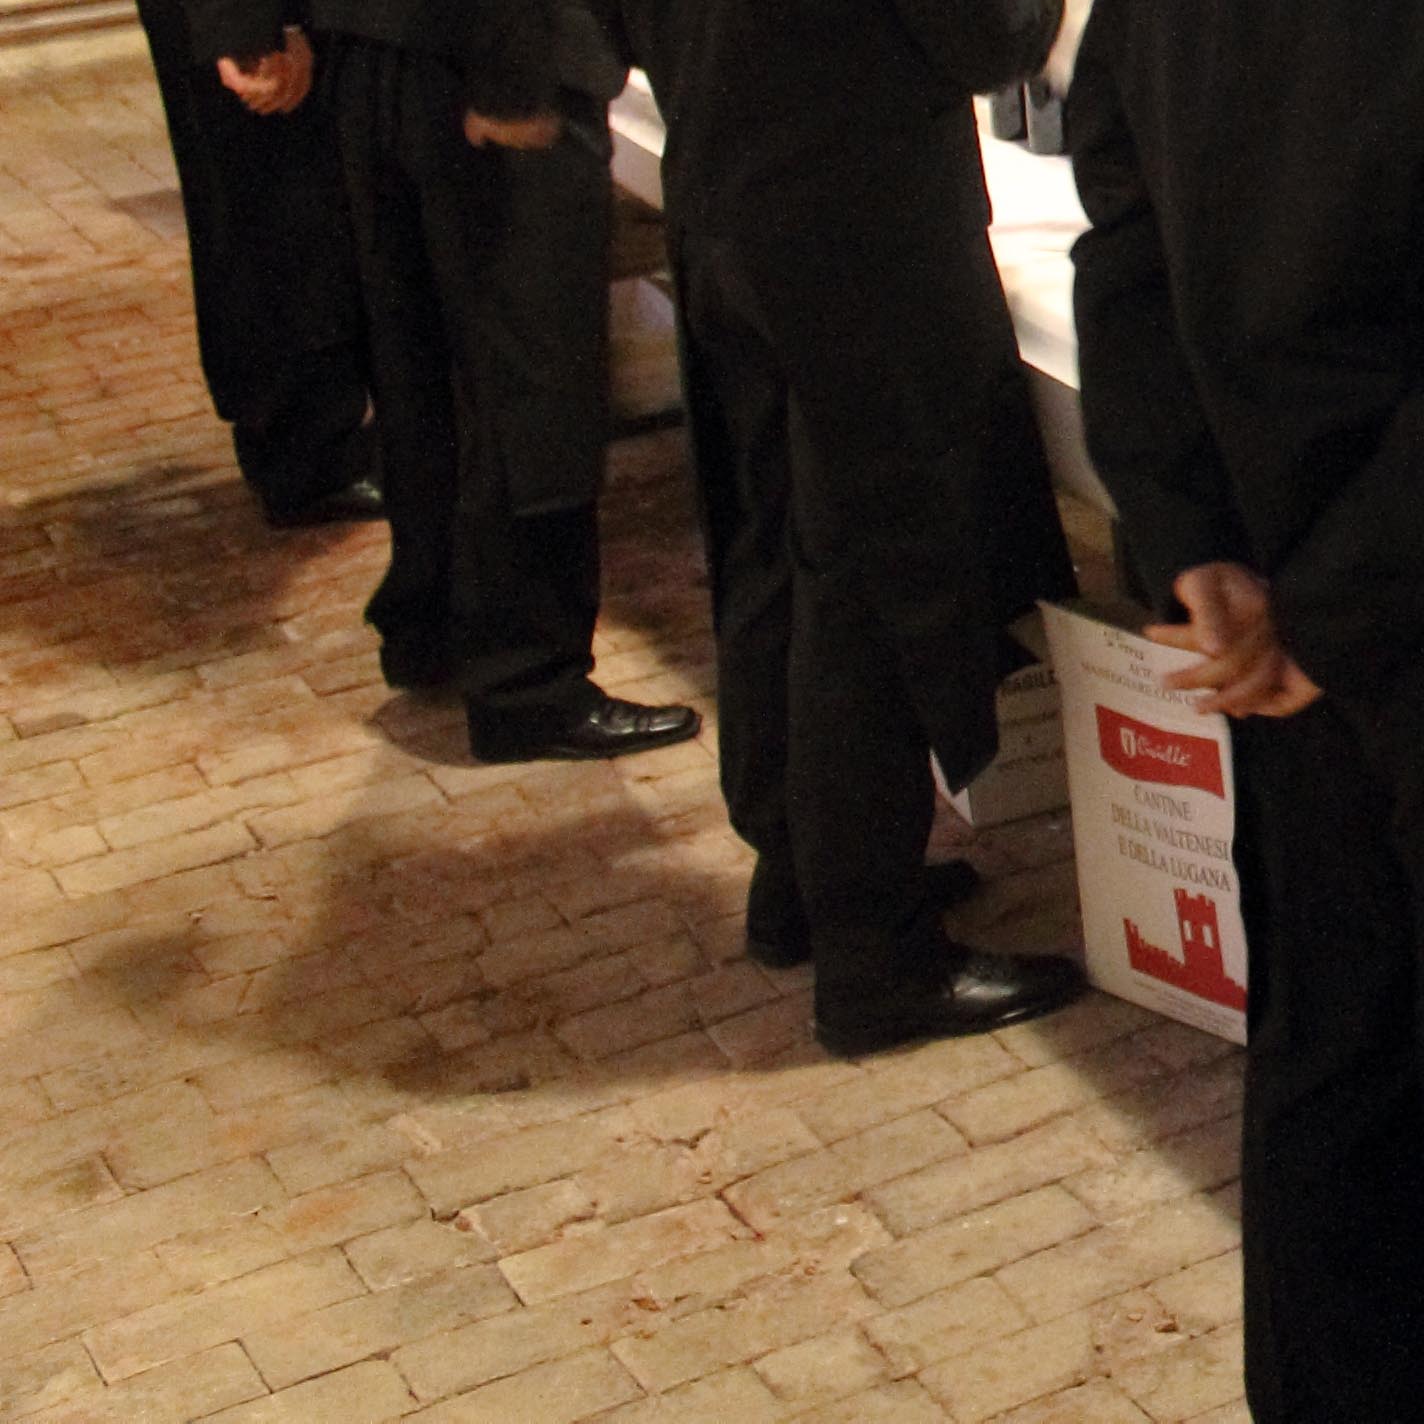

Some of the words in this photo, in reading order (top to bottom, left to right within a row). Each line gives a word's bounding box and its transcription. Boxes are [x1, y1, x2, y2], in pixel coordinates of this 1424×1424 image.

[1110, 802, 1152, 837] DELLA
[1133, 783, 1193, 822] CANTINE
[1127, 839, 1169, 874] DELLA
[1169, 856, 1232, 893] LUGANA
